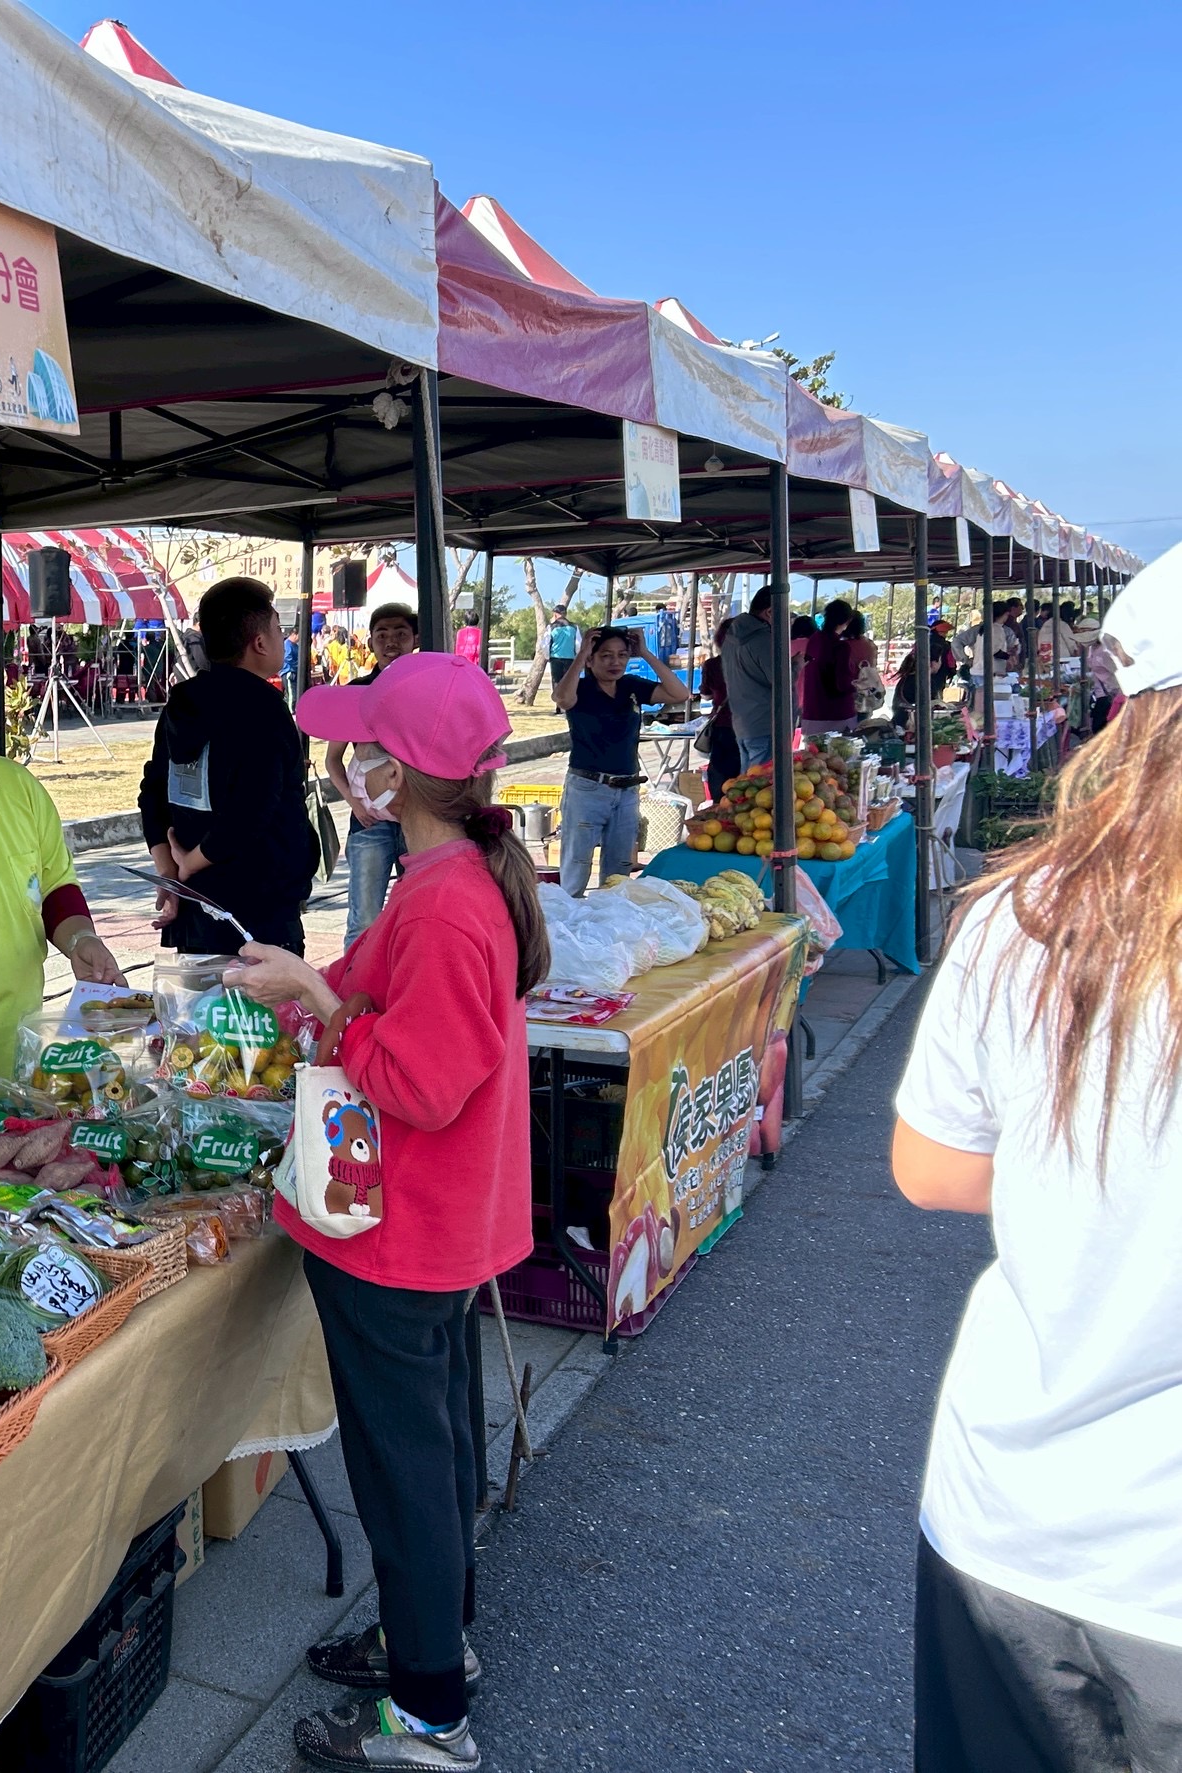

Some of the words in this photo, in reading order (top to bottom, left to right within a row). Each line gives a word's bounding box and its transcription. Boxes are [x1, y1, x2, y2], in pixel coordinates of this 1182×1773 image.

[238, 556, 277, 576] 北門
[212, 1006, 274, 1033] Fruit
[44, 1045, 95, 1063] Fruit
[73, 1126, 122, 1150] Fruit
[197, 1135, 254, 1159] Fruit
